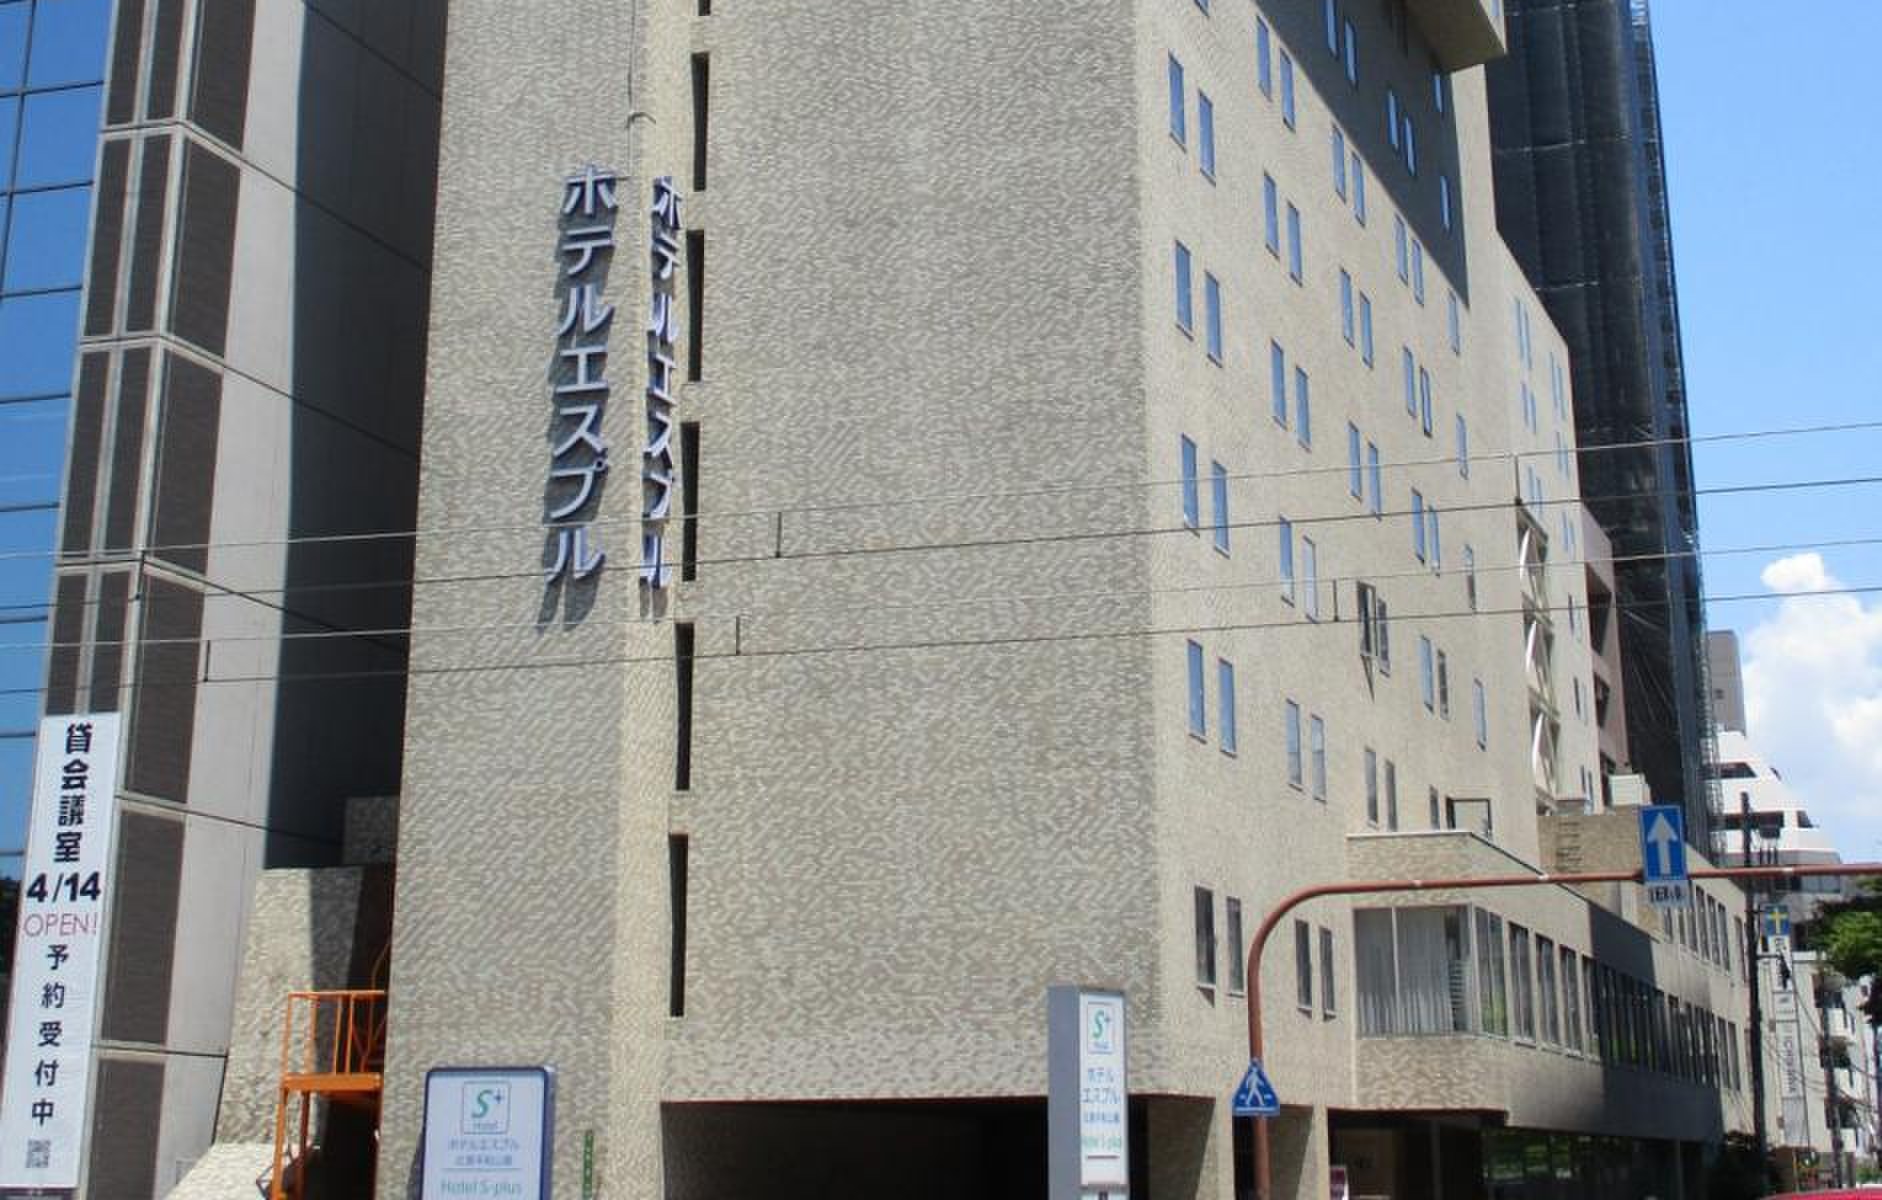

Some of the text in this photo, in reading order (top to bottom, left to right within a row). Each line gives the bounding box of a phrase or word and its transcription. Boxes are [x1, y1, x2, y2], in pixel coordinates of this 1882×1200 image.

[546, 163, 617, 584] ホテルエスプル
[53, 722, 94, 863] 貸会議室
[23, 912, 97, 937] OPEN!
[26, 871, 102, 903] 4/14
[32, 944, 69, 1126] 予約受付中
